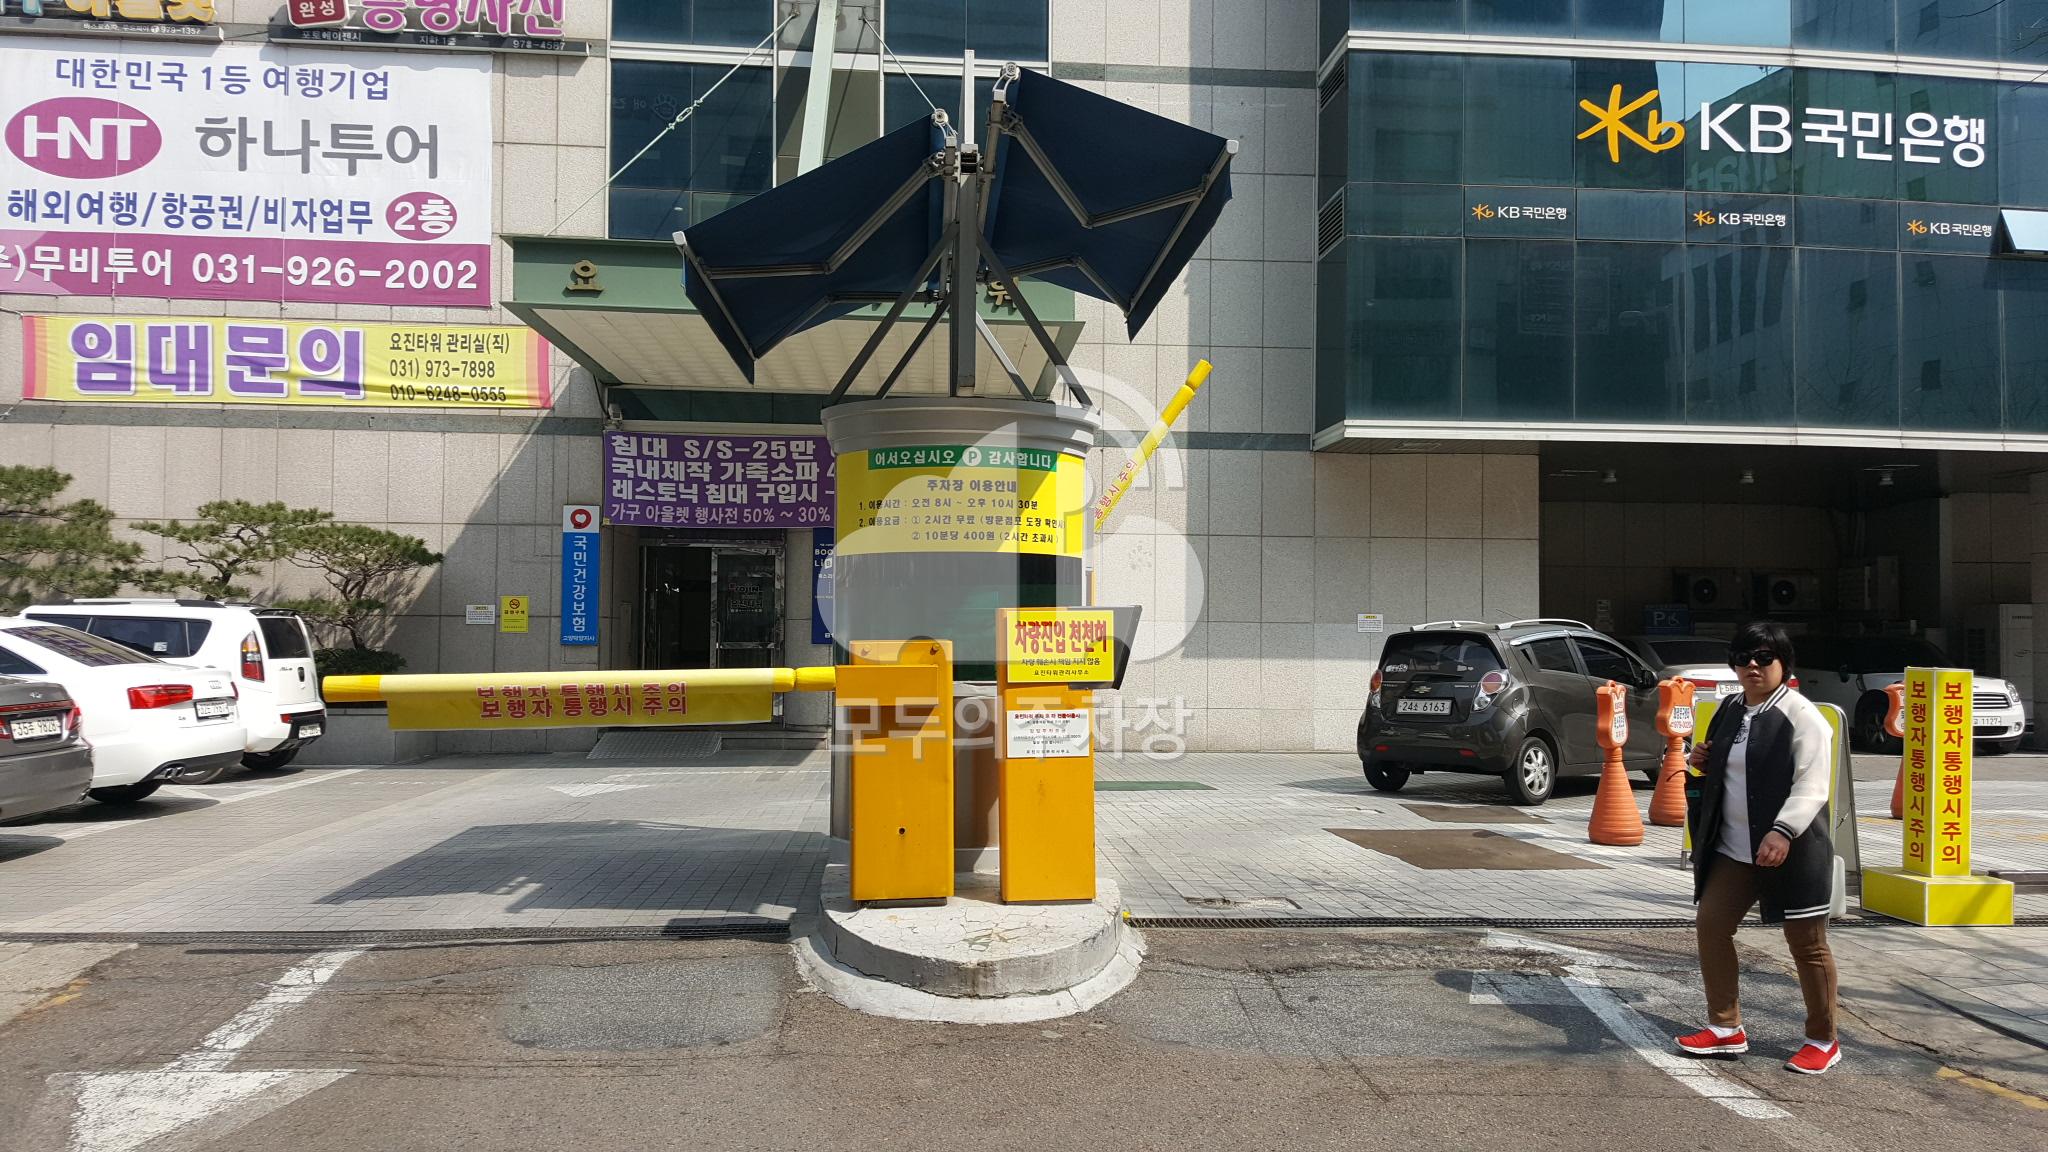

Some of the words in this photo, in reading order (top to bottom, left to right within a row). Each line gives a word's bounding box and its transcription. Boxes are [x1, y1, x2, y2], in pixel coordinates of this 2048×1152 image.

[56, 58, 188, 92] 대한민국
[201, 65, 251, 95] 1등
[263, 65, 389, 100] 여행기업
[24, 115, 148, 160] HNT
[195, 116, 438, 179] 하나투어
[7, 188, 373, 236] 해외여행/항공권/비자업무
[394, 198, 454, 234] 2층
[192, 252, 478, 290] 031-926-2002
[390, 332, 443, 352] 요진타워
[446, 333, 510, 354] 관리실(직)
[70, 322, 366, 400] 임대문의
[390, 359, 420, 379] 031)
[425, 360, 495, 378] 973-7898
[390, 384, 507, 402] 010-6248-0555
[611, 435, 668, 458] 침대
[684, 440, 816, 460] S/S-25만
[875, 450, 955, 465] 어서오십시오
[988, 451, 1051, 468] 감사합니다
[611, 457, 712, 482] 국내제작
[720, 462, 819, 482] 가죽소파
[611, 480, 699, 504] 레스토닉
[705, 484, 748, 504] 침대
[756, 484, 818, 503] 구입시
[927, 479, 963, 491] 주차장
[970, 480, 1017, 492] 이용안내
[611, 503, 641, 521] 가구
[646, 506, 689, 524] 아울렛
[695, 507, 738, 524] 행사전
[743, 509, 775, 523] 50%
[798, 507, 831, 523] 30%
[869, 499, 900, 509] 이용시간
[912, 499, 930, 508] 오전
[935, 499, 951, 507] 8시
[968, 499, 986, 508] 오후
[992, 500, 1014, 508] 10시
[1018, 501, 1038, 510] 30분
[869, 516, 900, 526] 이용요금
[925, 516, 951, 525] 2시간
[957, 516, 975, 525] 무료
[1026, 517, 1042, 527] 도장
[926, 532, 959, 540] 10분당
[963, 532, 995, 540] 400원
[572, 535, 587, 632] 국민건강보험
[1015, 620, 1066, 654] 차량진입
[1069, 620, 1107, 653] 천천히
[480, 698, 552, 718] 보행자
[562, 697, 632, 716] 통행시
[642, 696, 687, 716] 주의
[1423, 703, 1444, 711] 6163
[1910, 681, 1927, 862] 보행자통행시주의
[1941, 682, 1964, 864] 보행자통행시주의
